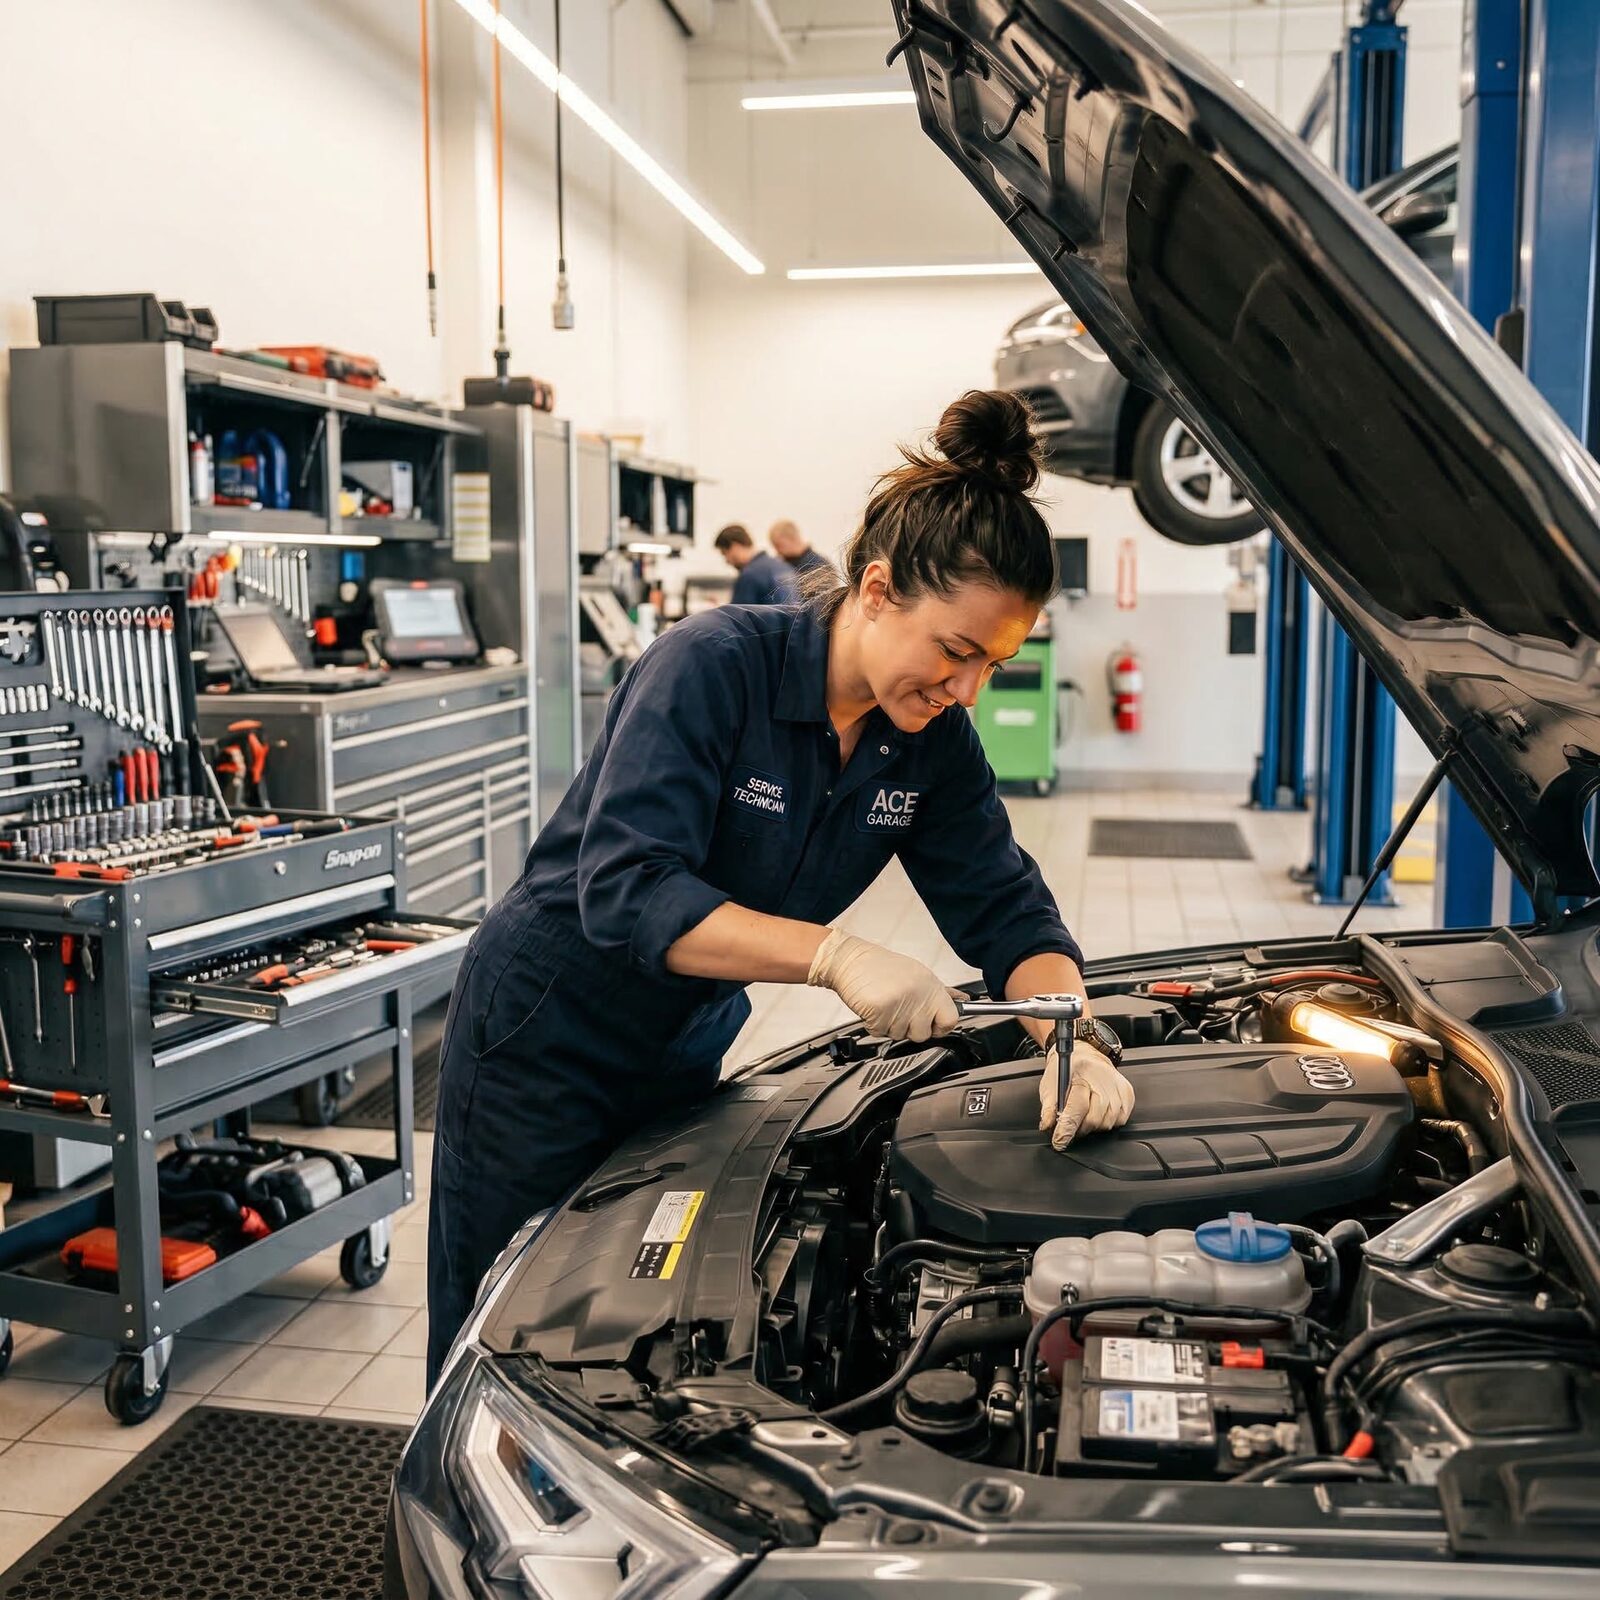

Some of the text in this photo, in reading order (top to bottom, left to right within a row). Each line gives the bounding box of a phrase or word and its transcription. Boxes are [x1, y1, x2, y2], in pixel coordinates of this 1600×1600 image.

[733, 786, 786, 814] TECHNICIAN
[747, 777, 783, 799] SERVICE
[871, 788, 920, 814] ACE
[866, 813, 913, 827] GARAGE
